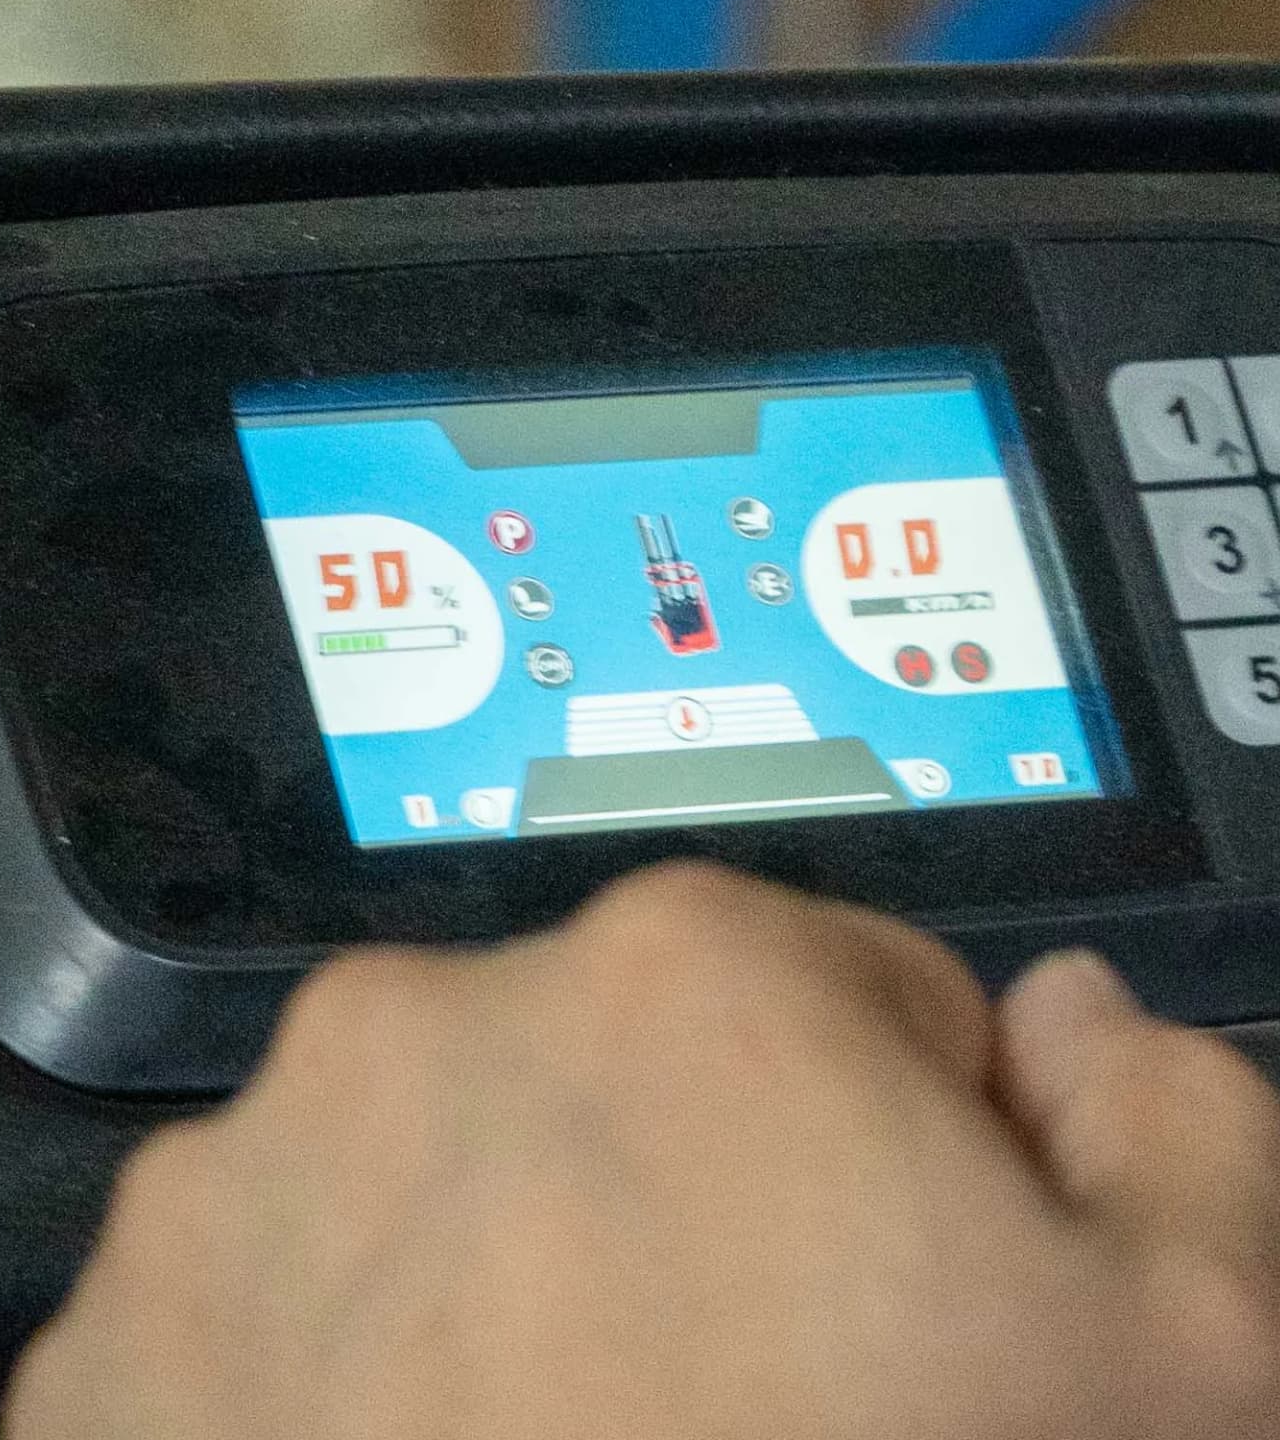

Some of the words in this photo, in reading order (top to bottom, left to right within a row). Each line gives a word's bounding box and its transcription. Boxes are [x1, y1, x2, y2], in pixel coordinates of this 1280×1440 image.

[1165, 396, 1198, 445] 1
[493, 516, 527, 550] P
[1207, 526, 1246, 574] 3
[958, 643, 988, 683] S
